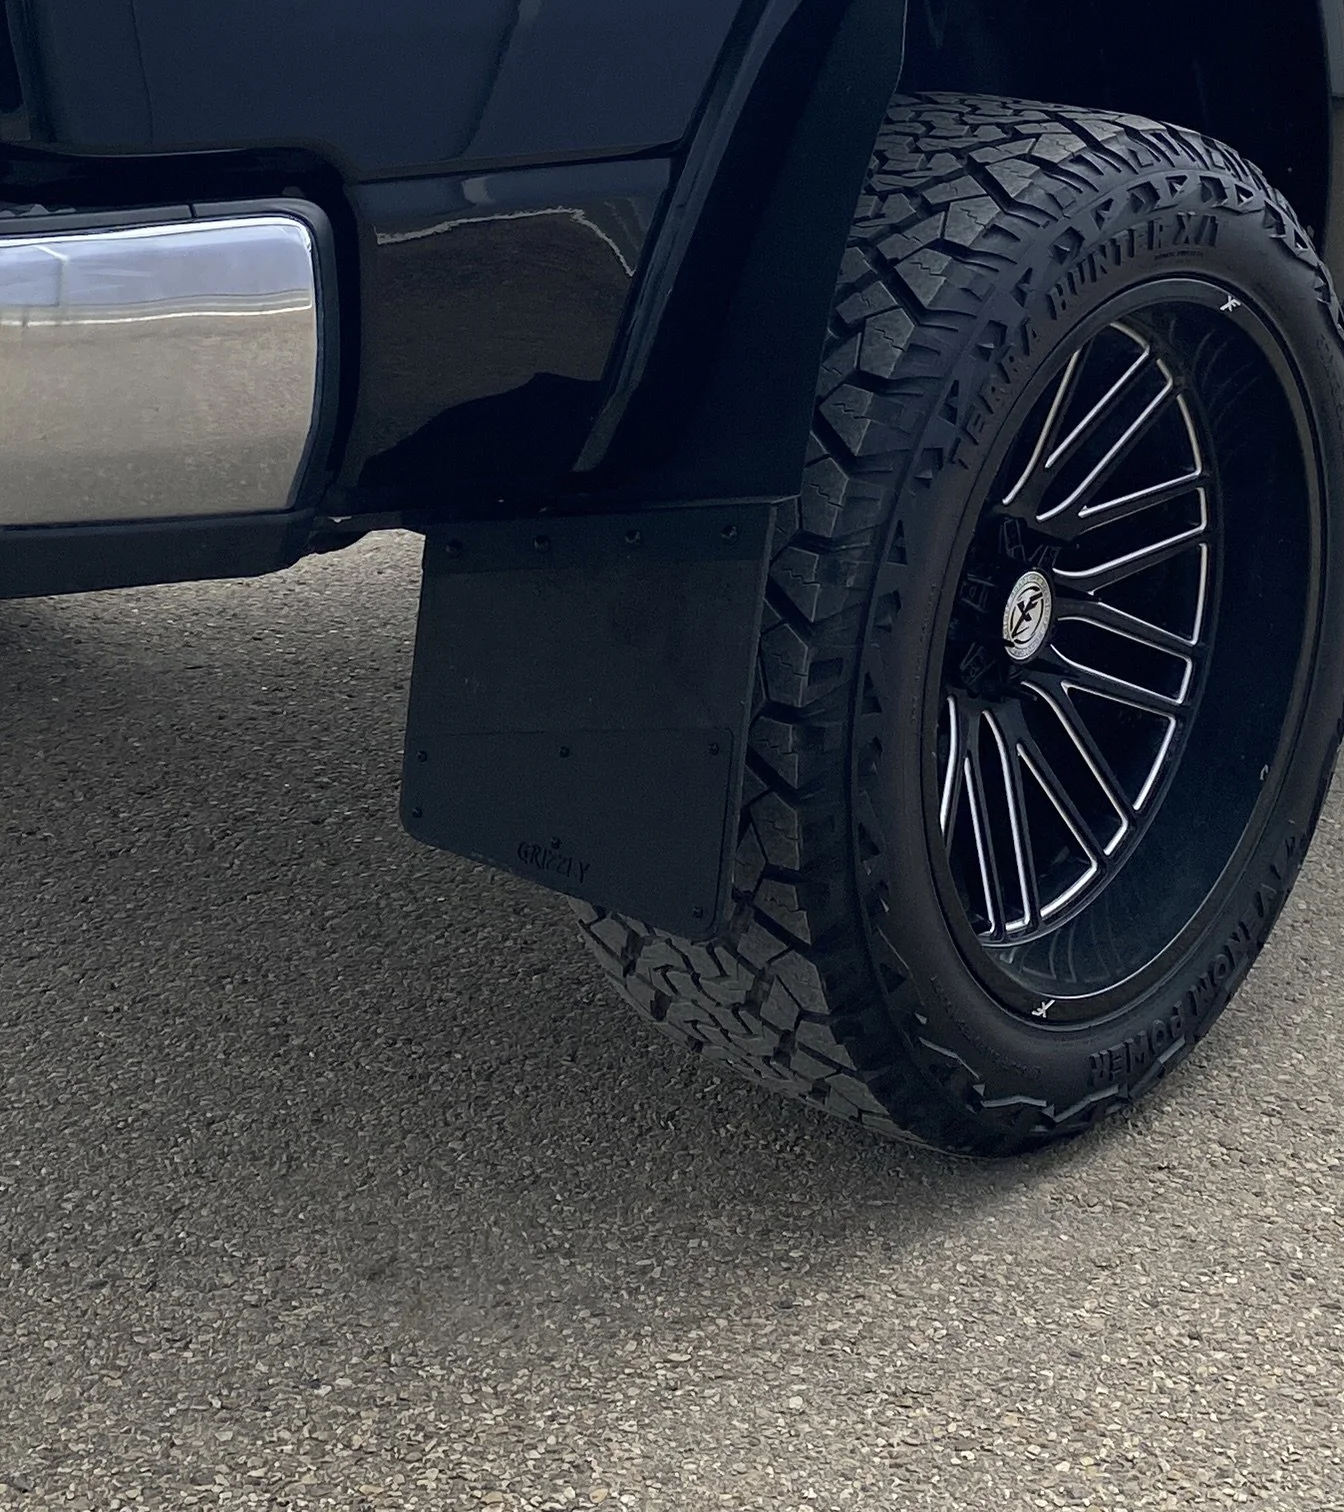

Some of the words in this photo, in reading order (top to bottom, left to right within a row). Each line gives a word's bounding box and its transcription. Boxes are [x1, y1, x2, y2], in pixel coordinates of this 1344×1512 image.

[947, 317, 1040, 472] TERRA
[1045, 215, 1170, 321] HUNTER
[1088, 999, 1187, 1084] POWER
